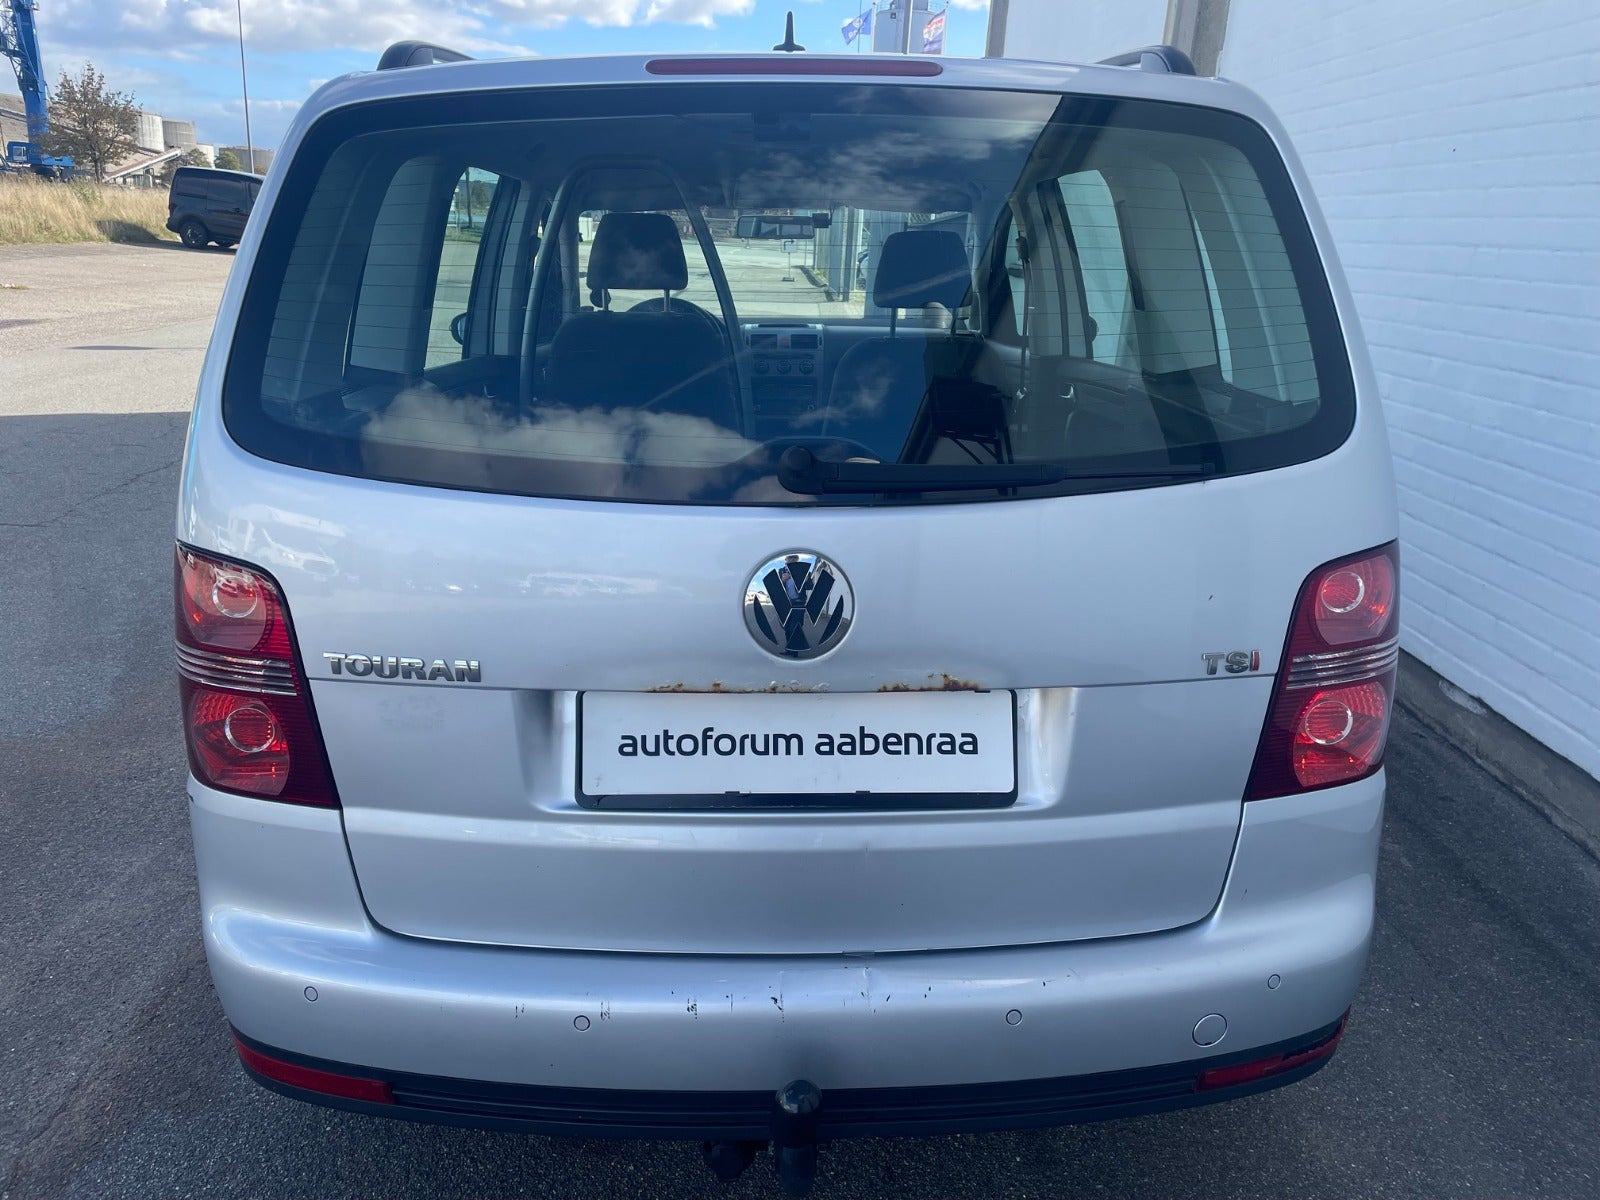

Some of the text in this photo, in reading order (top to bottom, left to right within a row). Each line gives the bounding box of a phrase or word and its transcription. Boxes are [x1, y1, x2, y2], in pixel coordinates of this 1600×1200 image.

[322, 652, 482, 683] TOURAN
[1202, 649, 1261, 676] TSI
[617, 725, 979, 757] autoforum aabenraa
